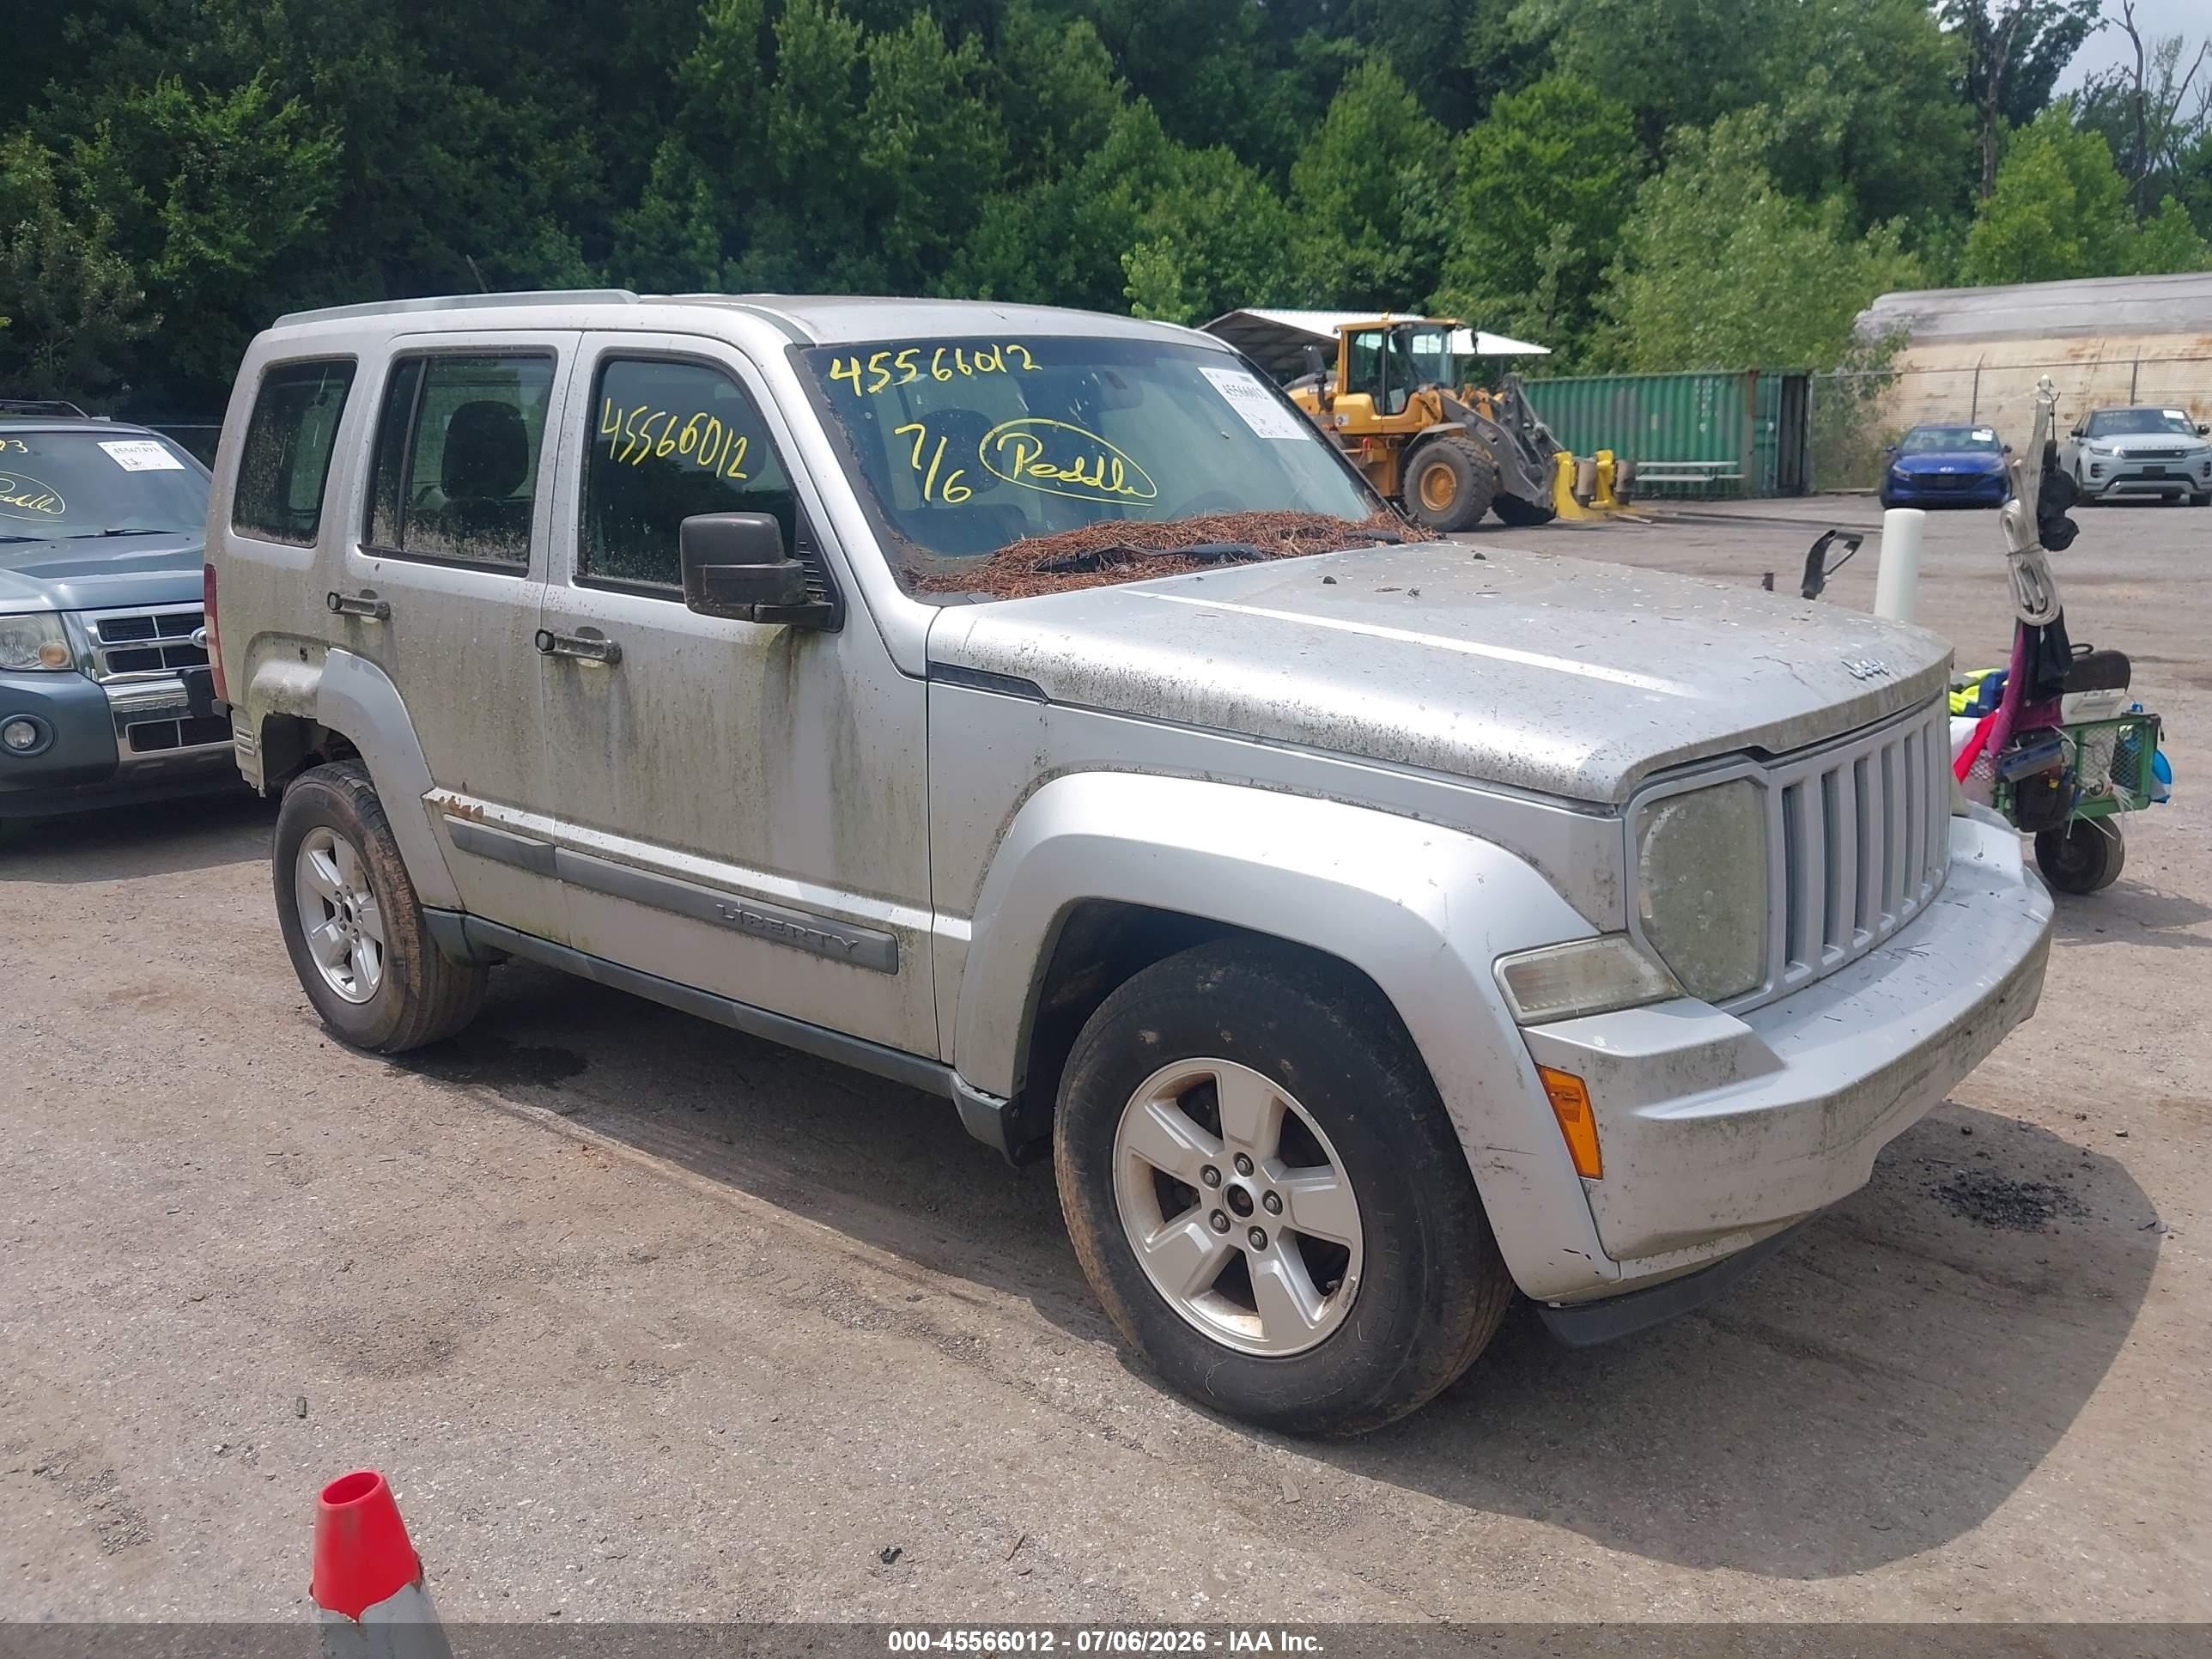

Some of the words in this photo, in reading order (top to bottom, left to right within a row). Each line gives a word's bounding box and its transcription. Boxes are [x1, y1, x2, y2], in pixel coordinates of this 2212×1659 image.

[829, 343, 1044, 398] 45566012
[600, 398, 748, 480] 45566012
[894, 422, 973, 503] 7/6
[122, 698, 188, 714] ESCAPE
[715, 903, 860, 953] LIBERTY
